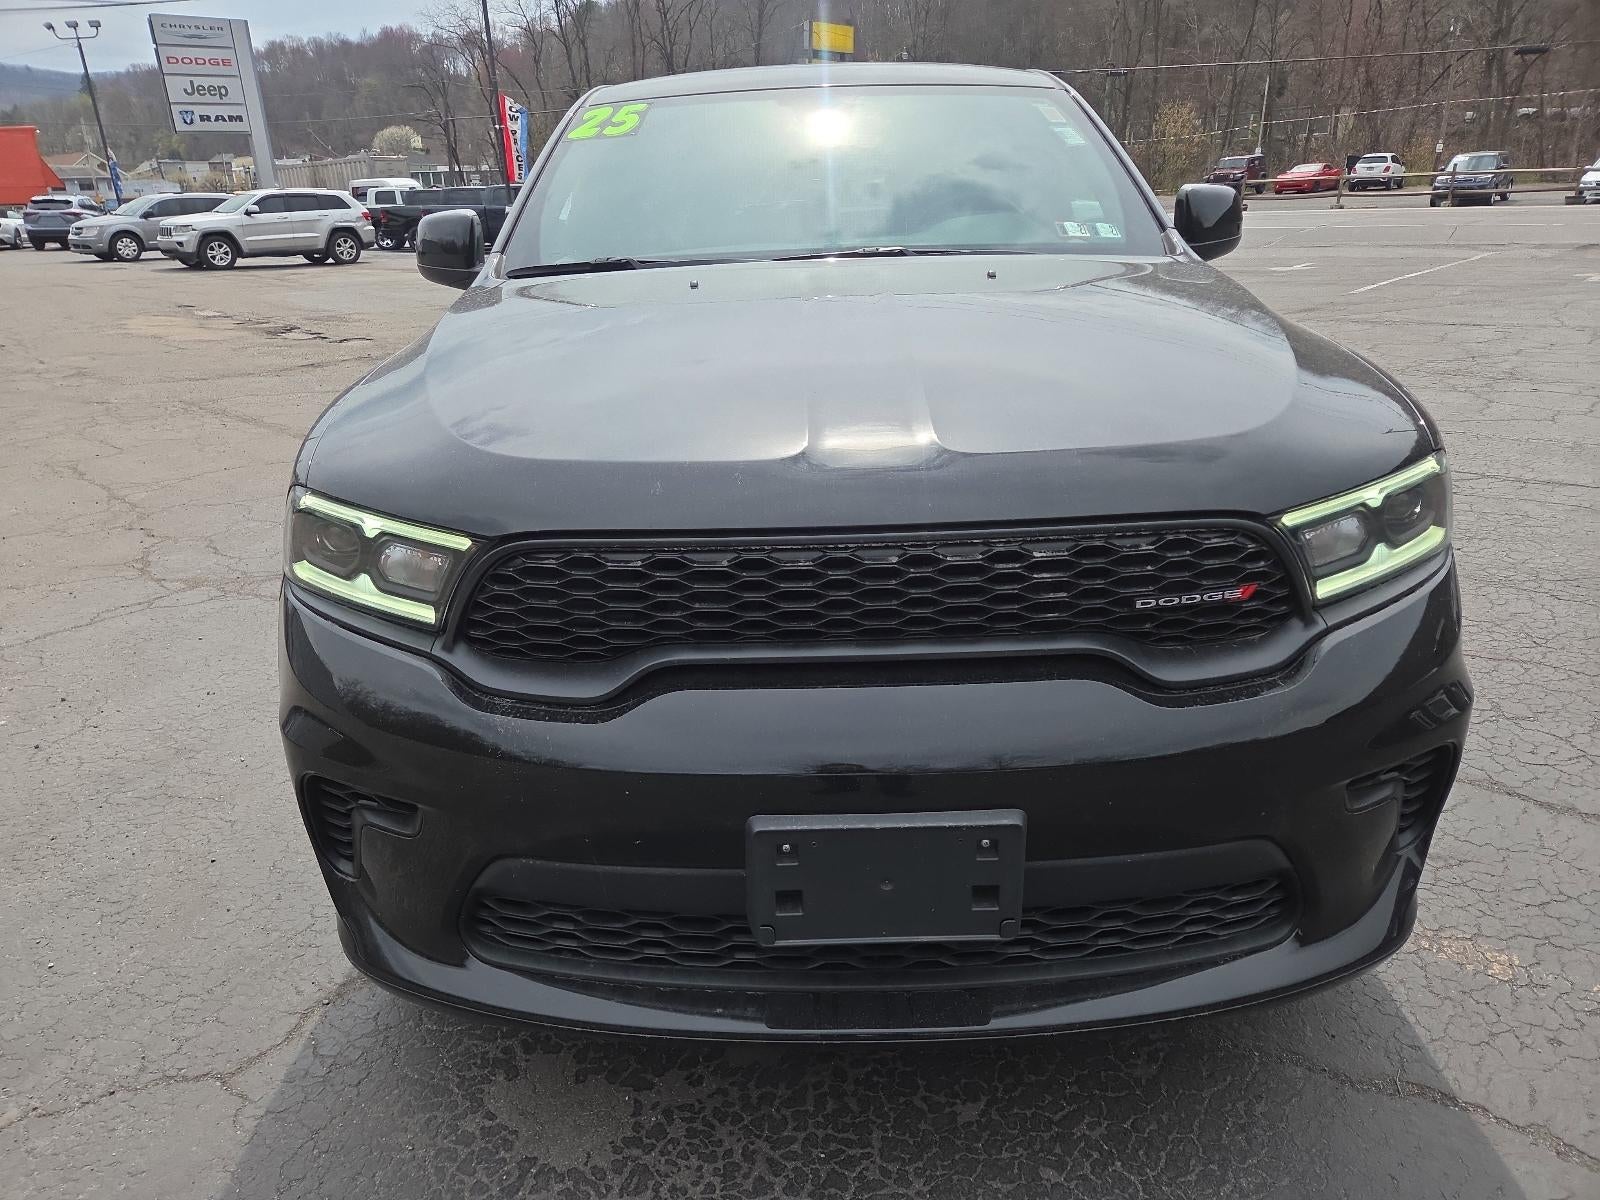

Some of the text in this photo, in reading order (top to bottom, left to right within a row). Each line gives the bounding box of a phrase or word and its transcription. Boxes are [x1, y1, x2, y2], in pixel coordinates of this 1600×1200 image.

[160, 22, 224, 32] CHRYSLER
[166, 56, 232, 67] DODGE
[183, 80, 229, 100] Jeep
[199, 114, 244, 122] RAM
[567, 103, 648, 140] 25
[510, 129, 523, 180] PRICES
[1135, 589, 1243, 609] DODGE
